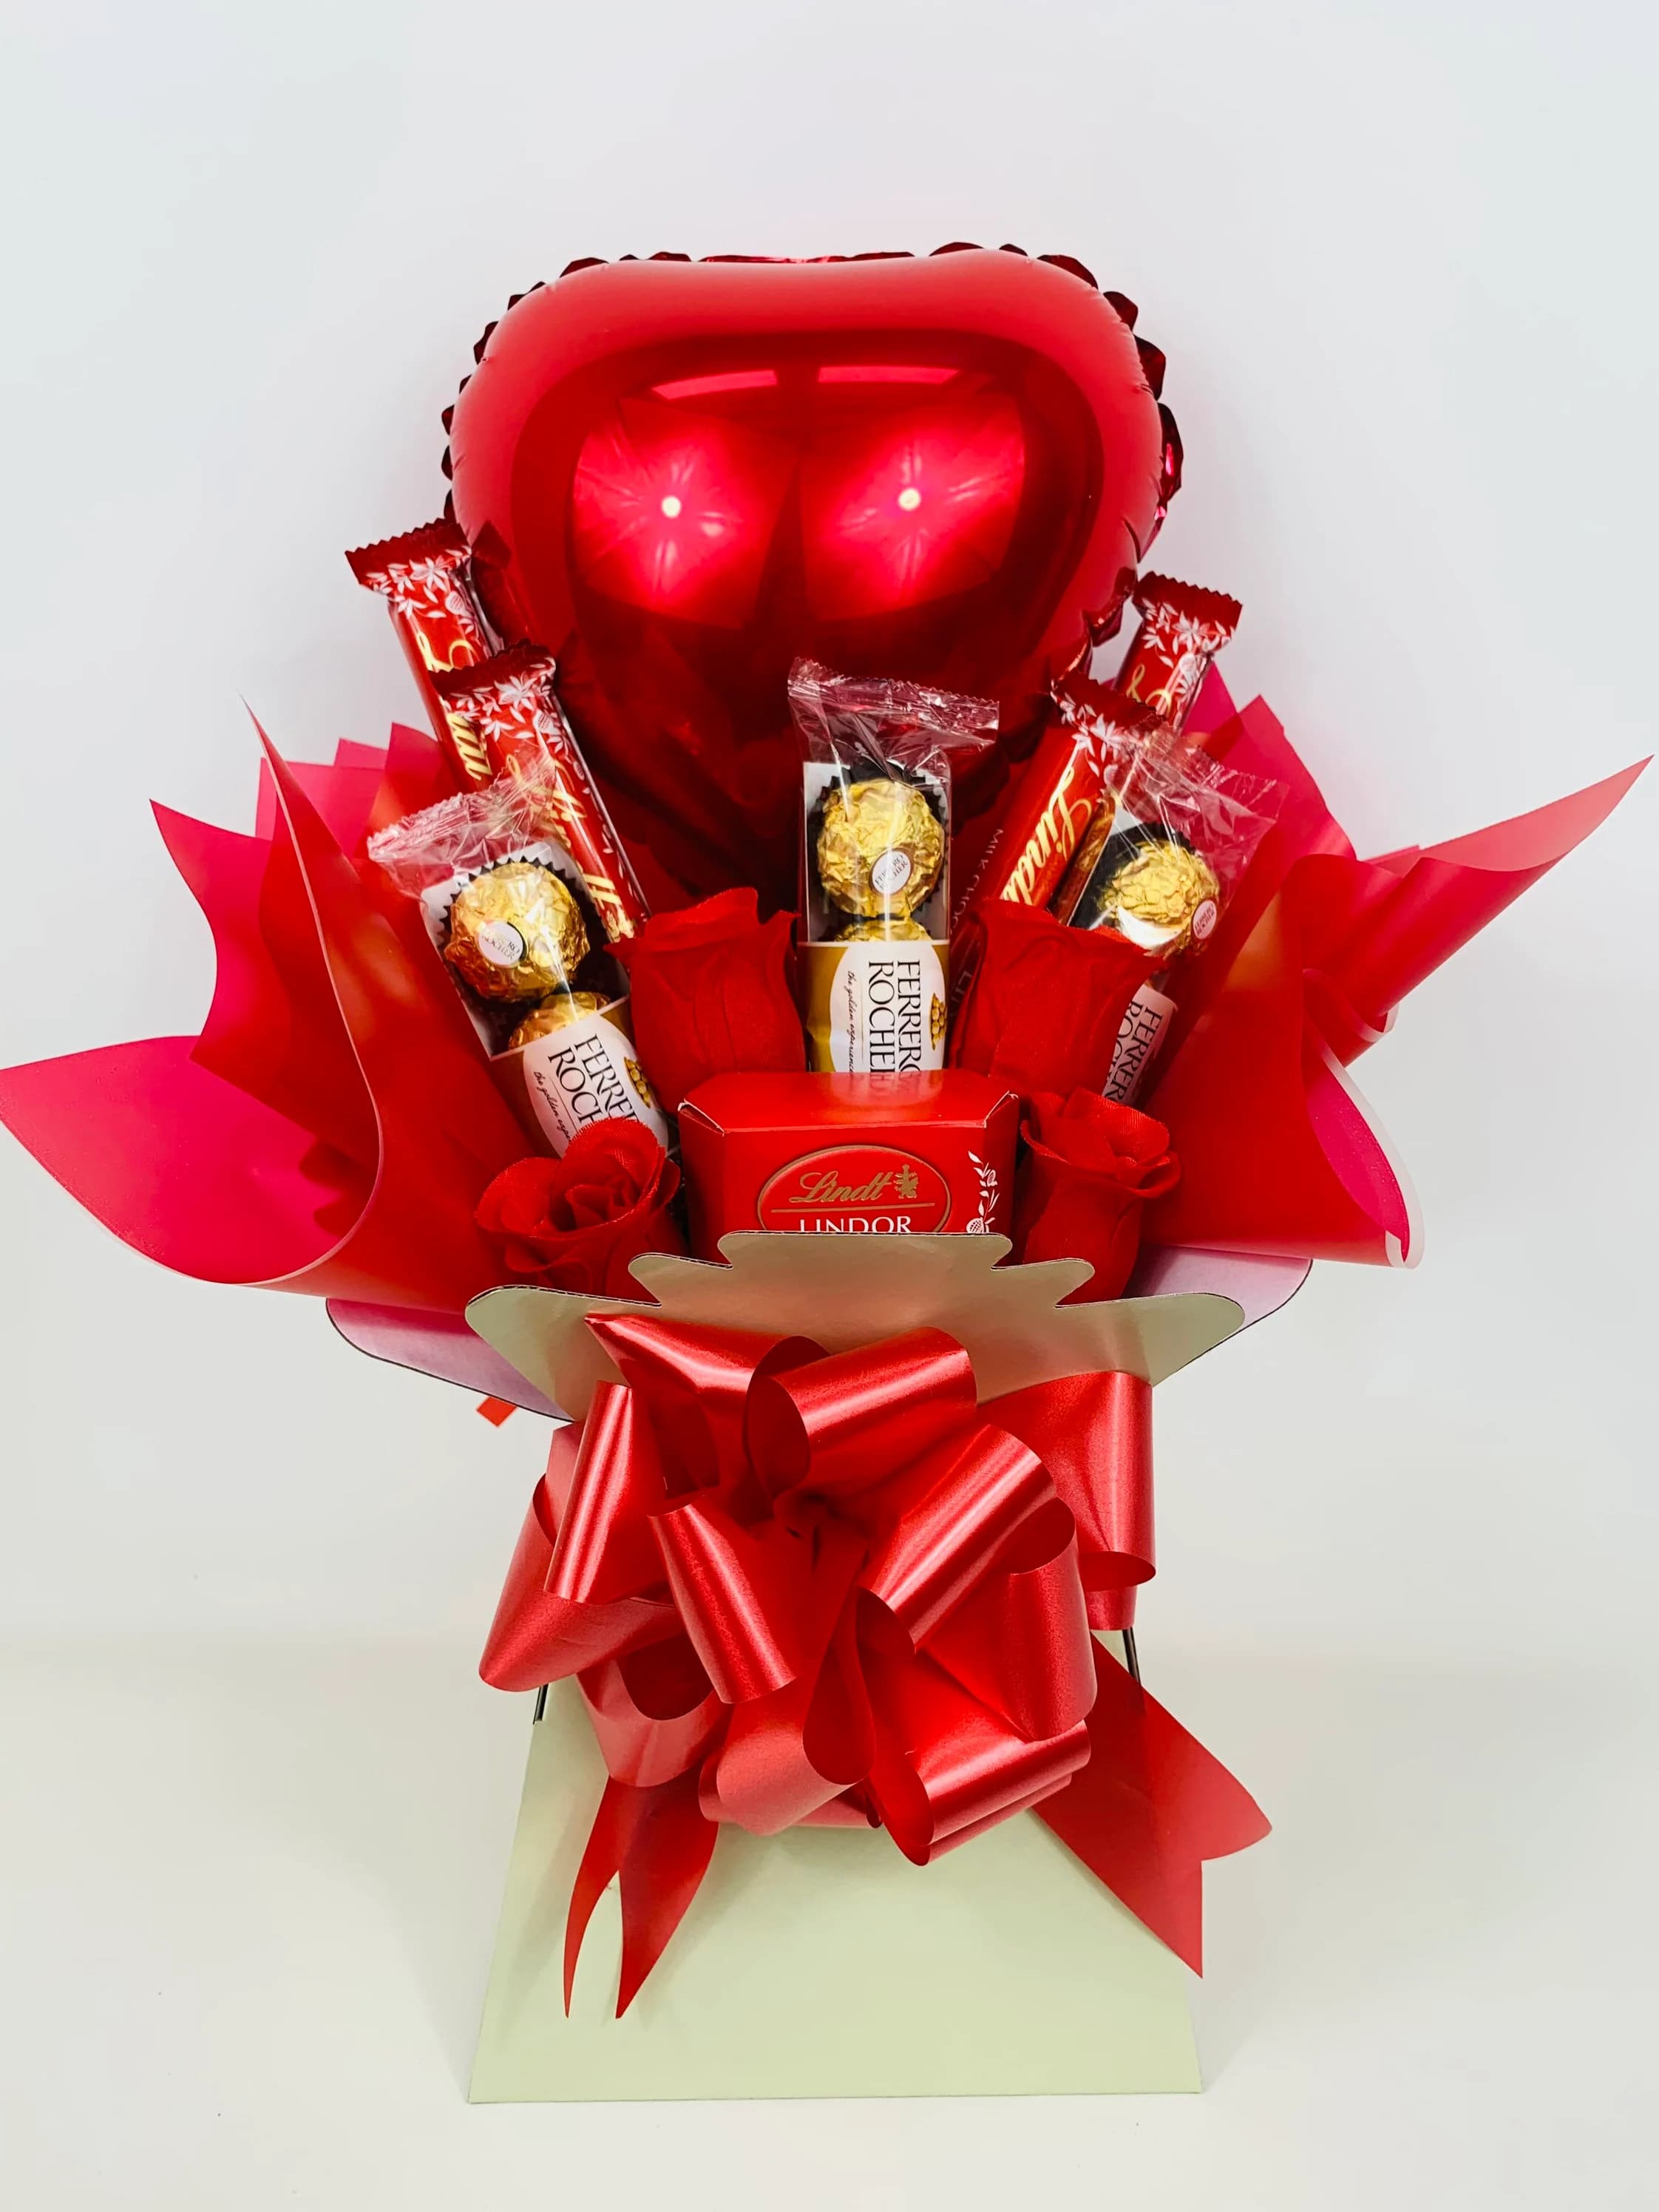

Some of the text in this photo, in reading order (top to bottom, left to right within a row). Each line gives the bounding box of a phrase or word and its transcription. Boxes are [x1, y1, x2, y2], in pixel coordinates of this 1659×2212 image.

[847, 970, 857, 985] the
[844, 985, 858, 1020] golden
[1104, 1006, 1163, 1101] FERRER
[534, 1071, 546, 1086] the
[537, 1084, 559, 1118] golden
[789, 1170, 894, 1203] Lindt
